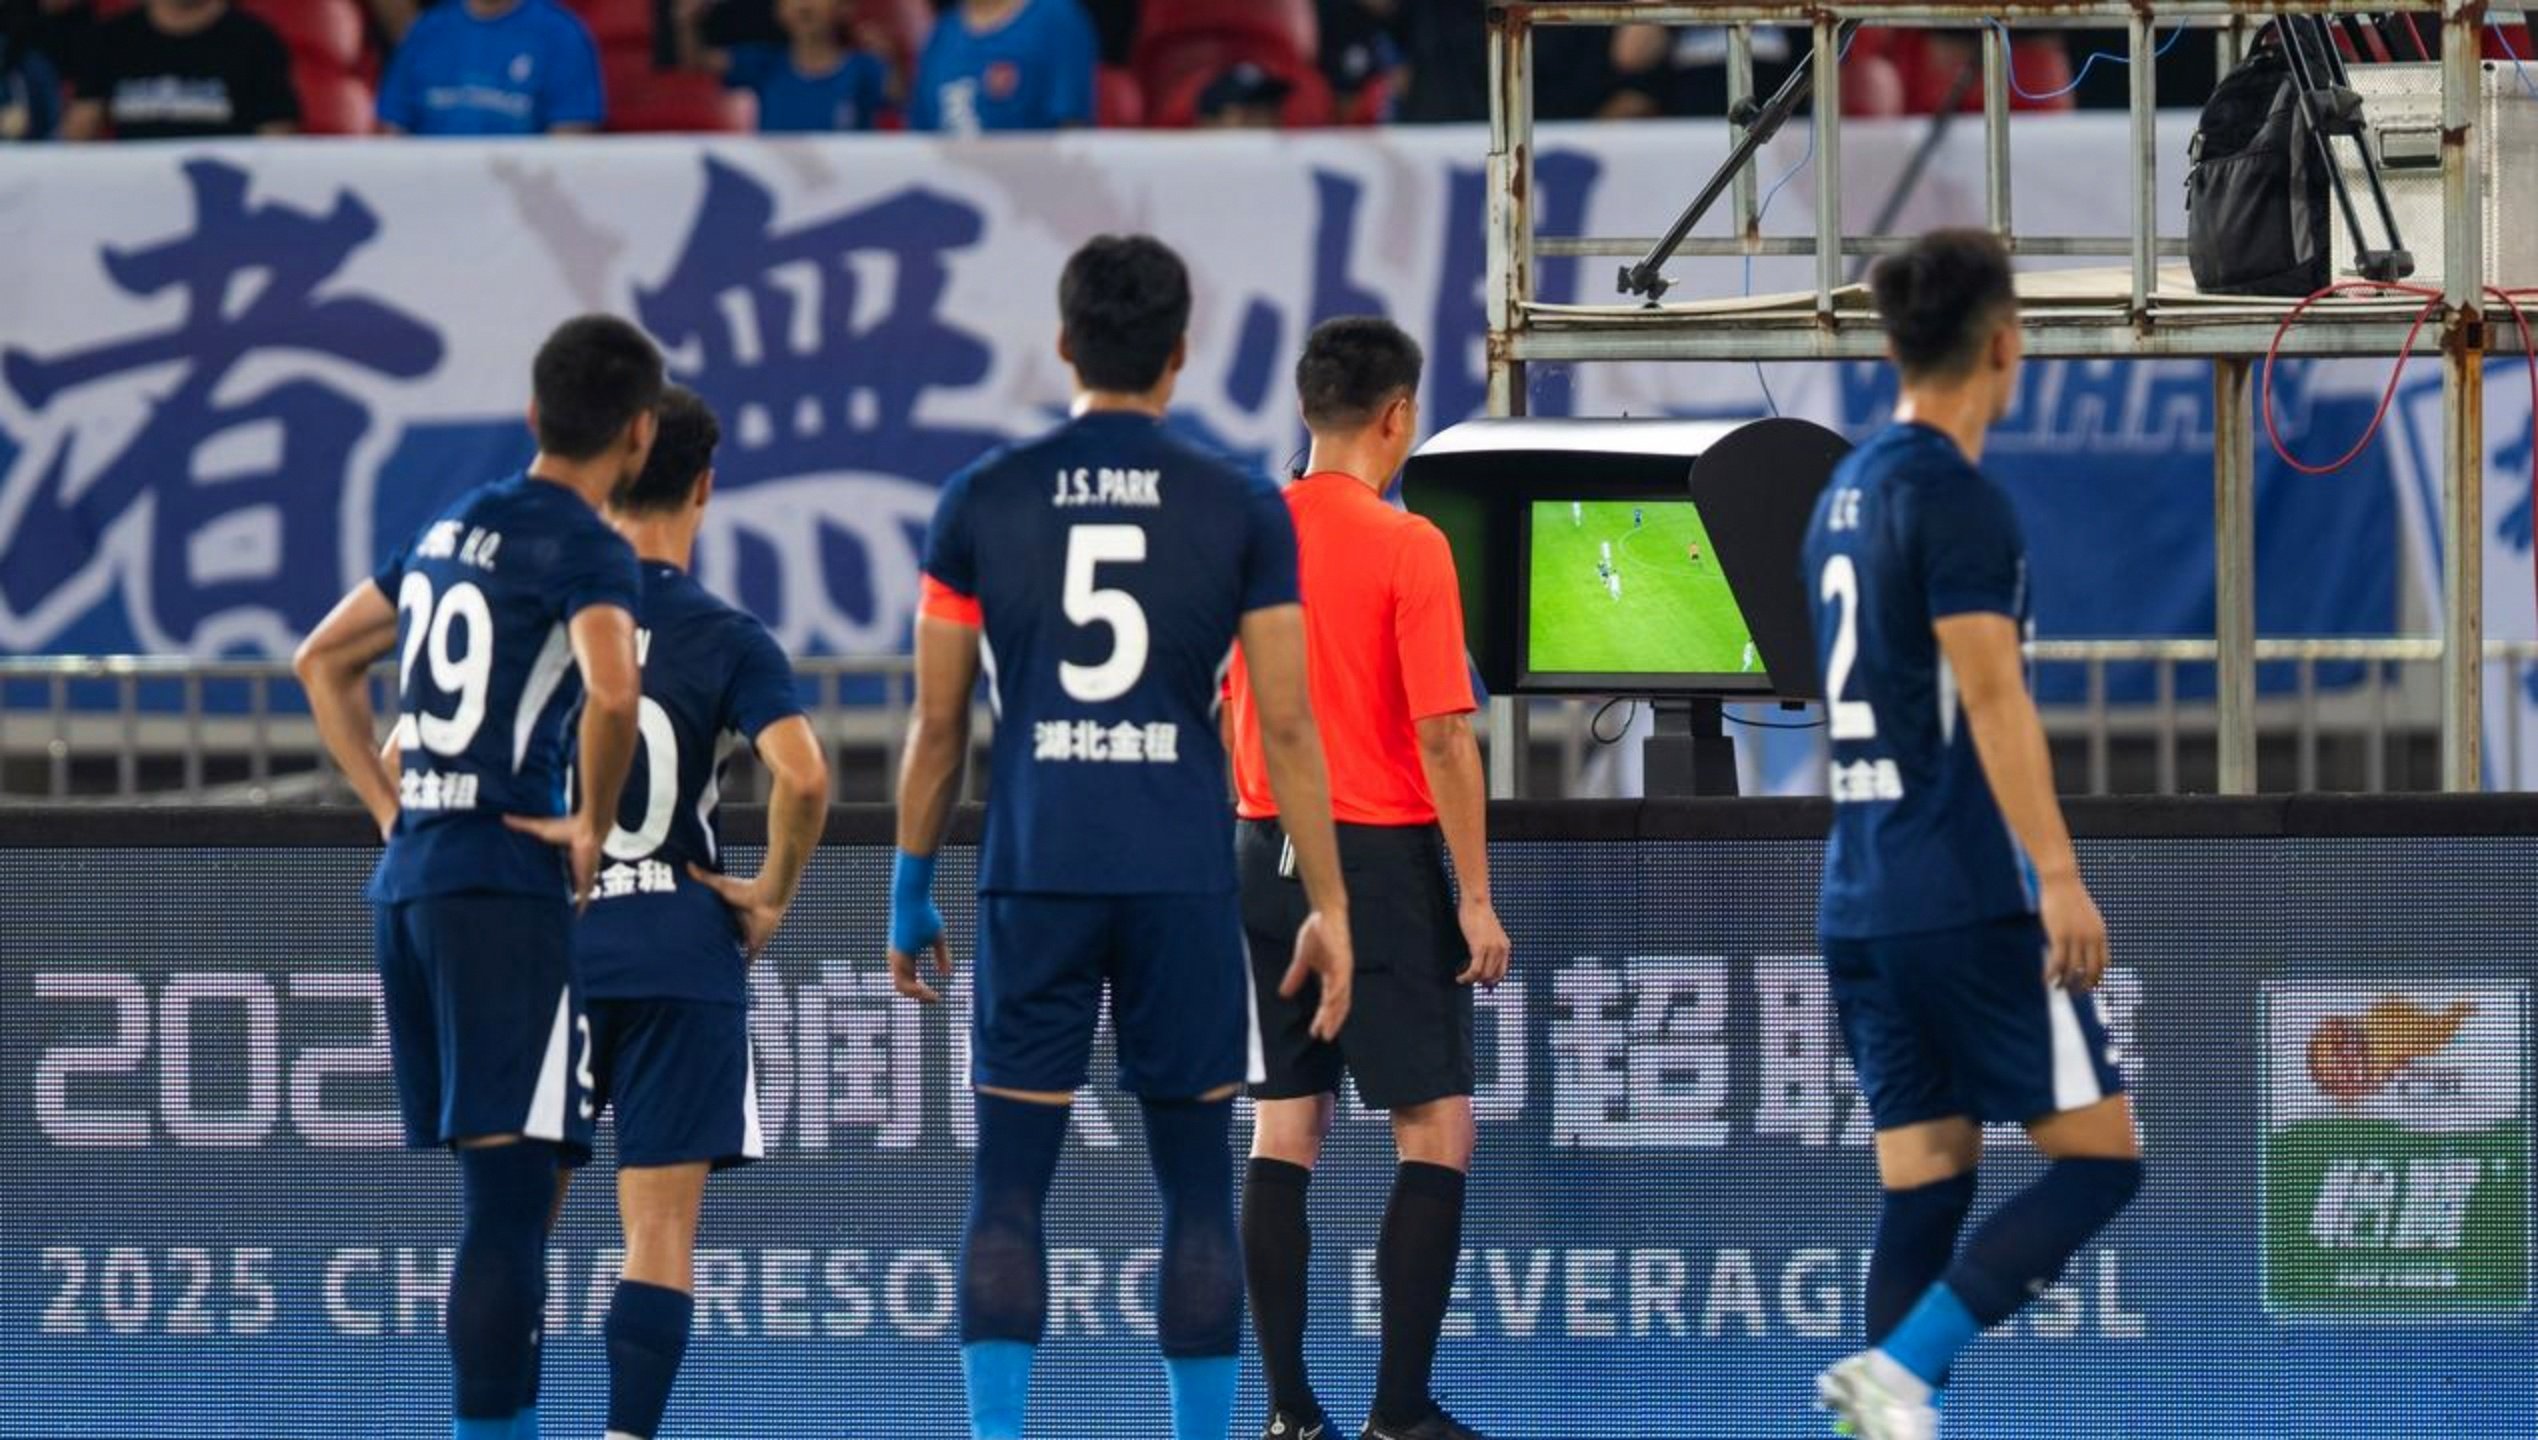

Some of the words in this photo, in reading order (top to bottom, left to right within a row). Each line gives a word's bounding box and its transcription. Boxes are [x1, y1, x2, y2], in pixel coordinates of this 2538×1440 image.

[398, 571, 493, 756] 29
[1058, 523, 1149, 702] 5
[1821, 554, 1877, 740] 2
[1033, 719, 1178, 762] 湖北金租
[587, 858, 677, 900] 金租
[34, 972, 402, 1147] 202
[41, 1247, 276, 1335] 2025
